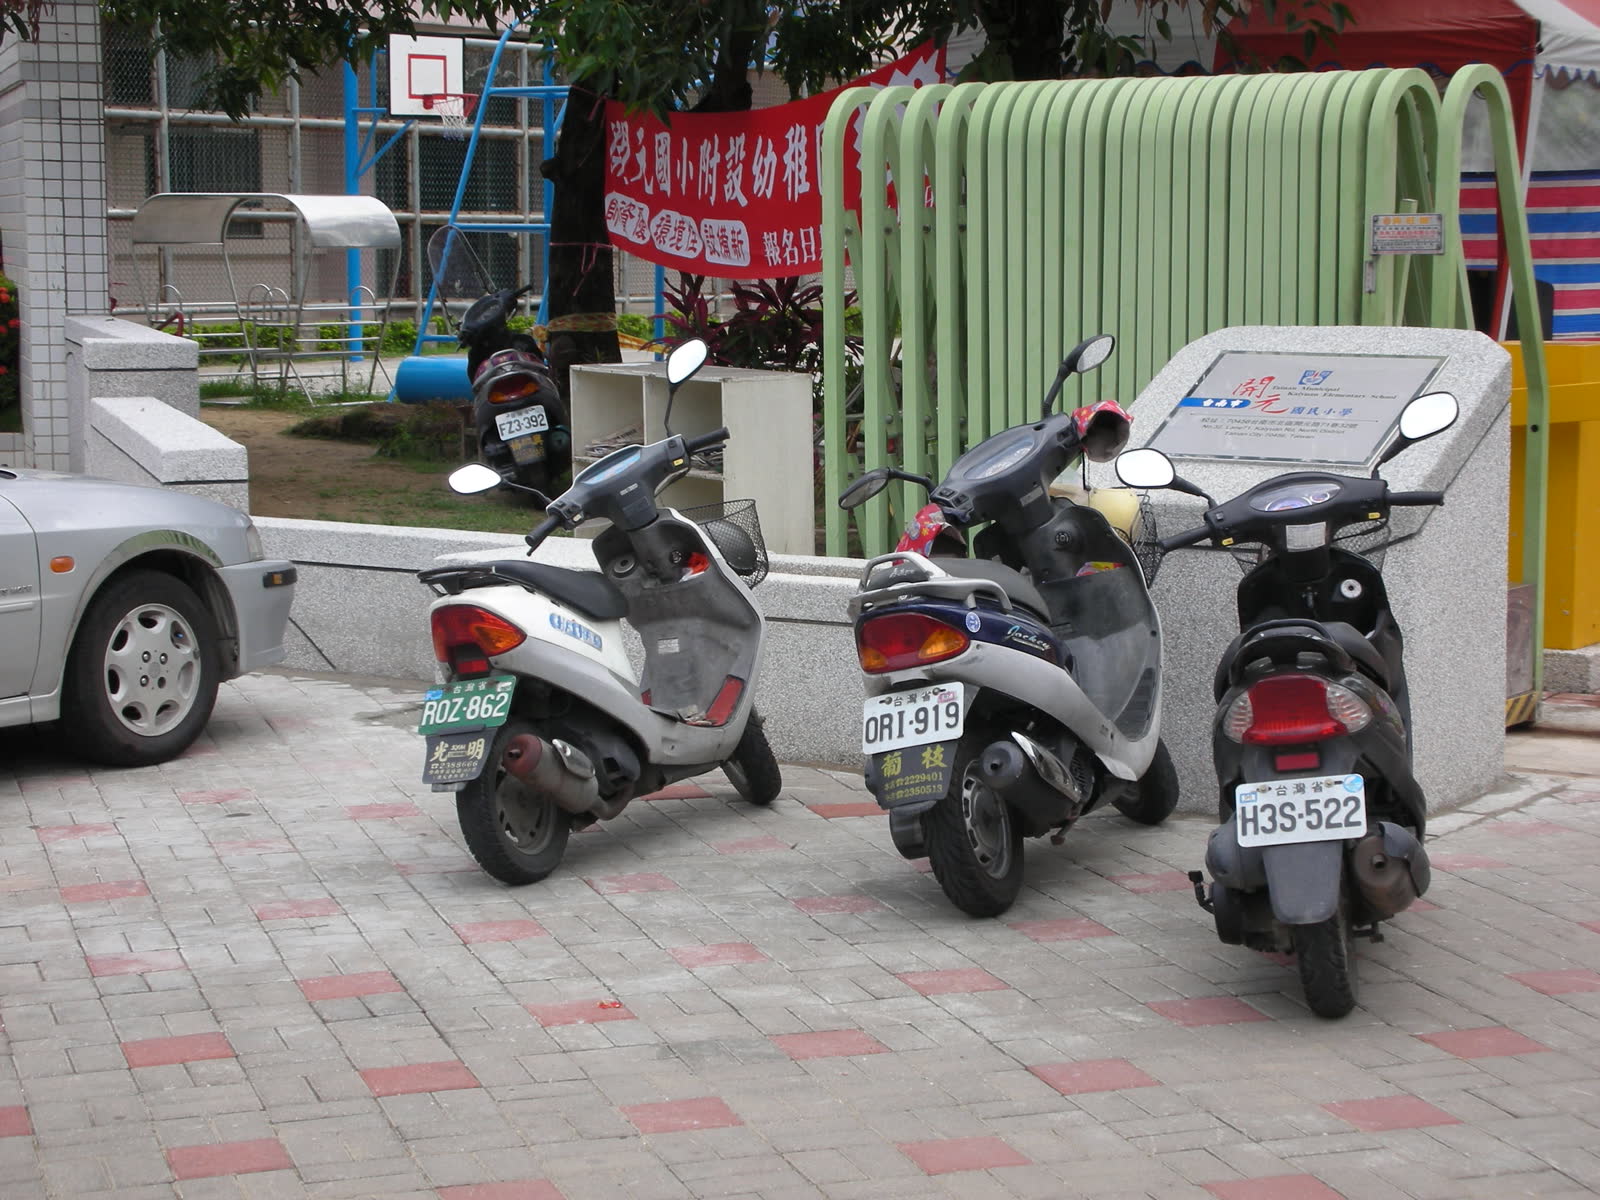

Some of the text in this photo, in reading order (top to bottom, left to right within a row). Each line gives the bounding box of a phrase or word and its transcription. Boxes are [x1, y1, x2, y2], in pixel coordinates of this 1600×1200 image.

[609, 120, 824, 207] 開元國小附設幼稚
[762, 226, 824, 267] 報名日
[1275, 781, 1324, 797] 台灣省
[1241, 796, 1362, 837] H3S-522
